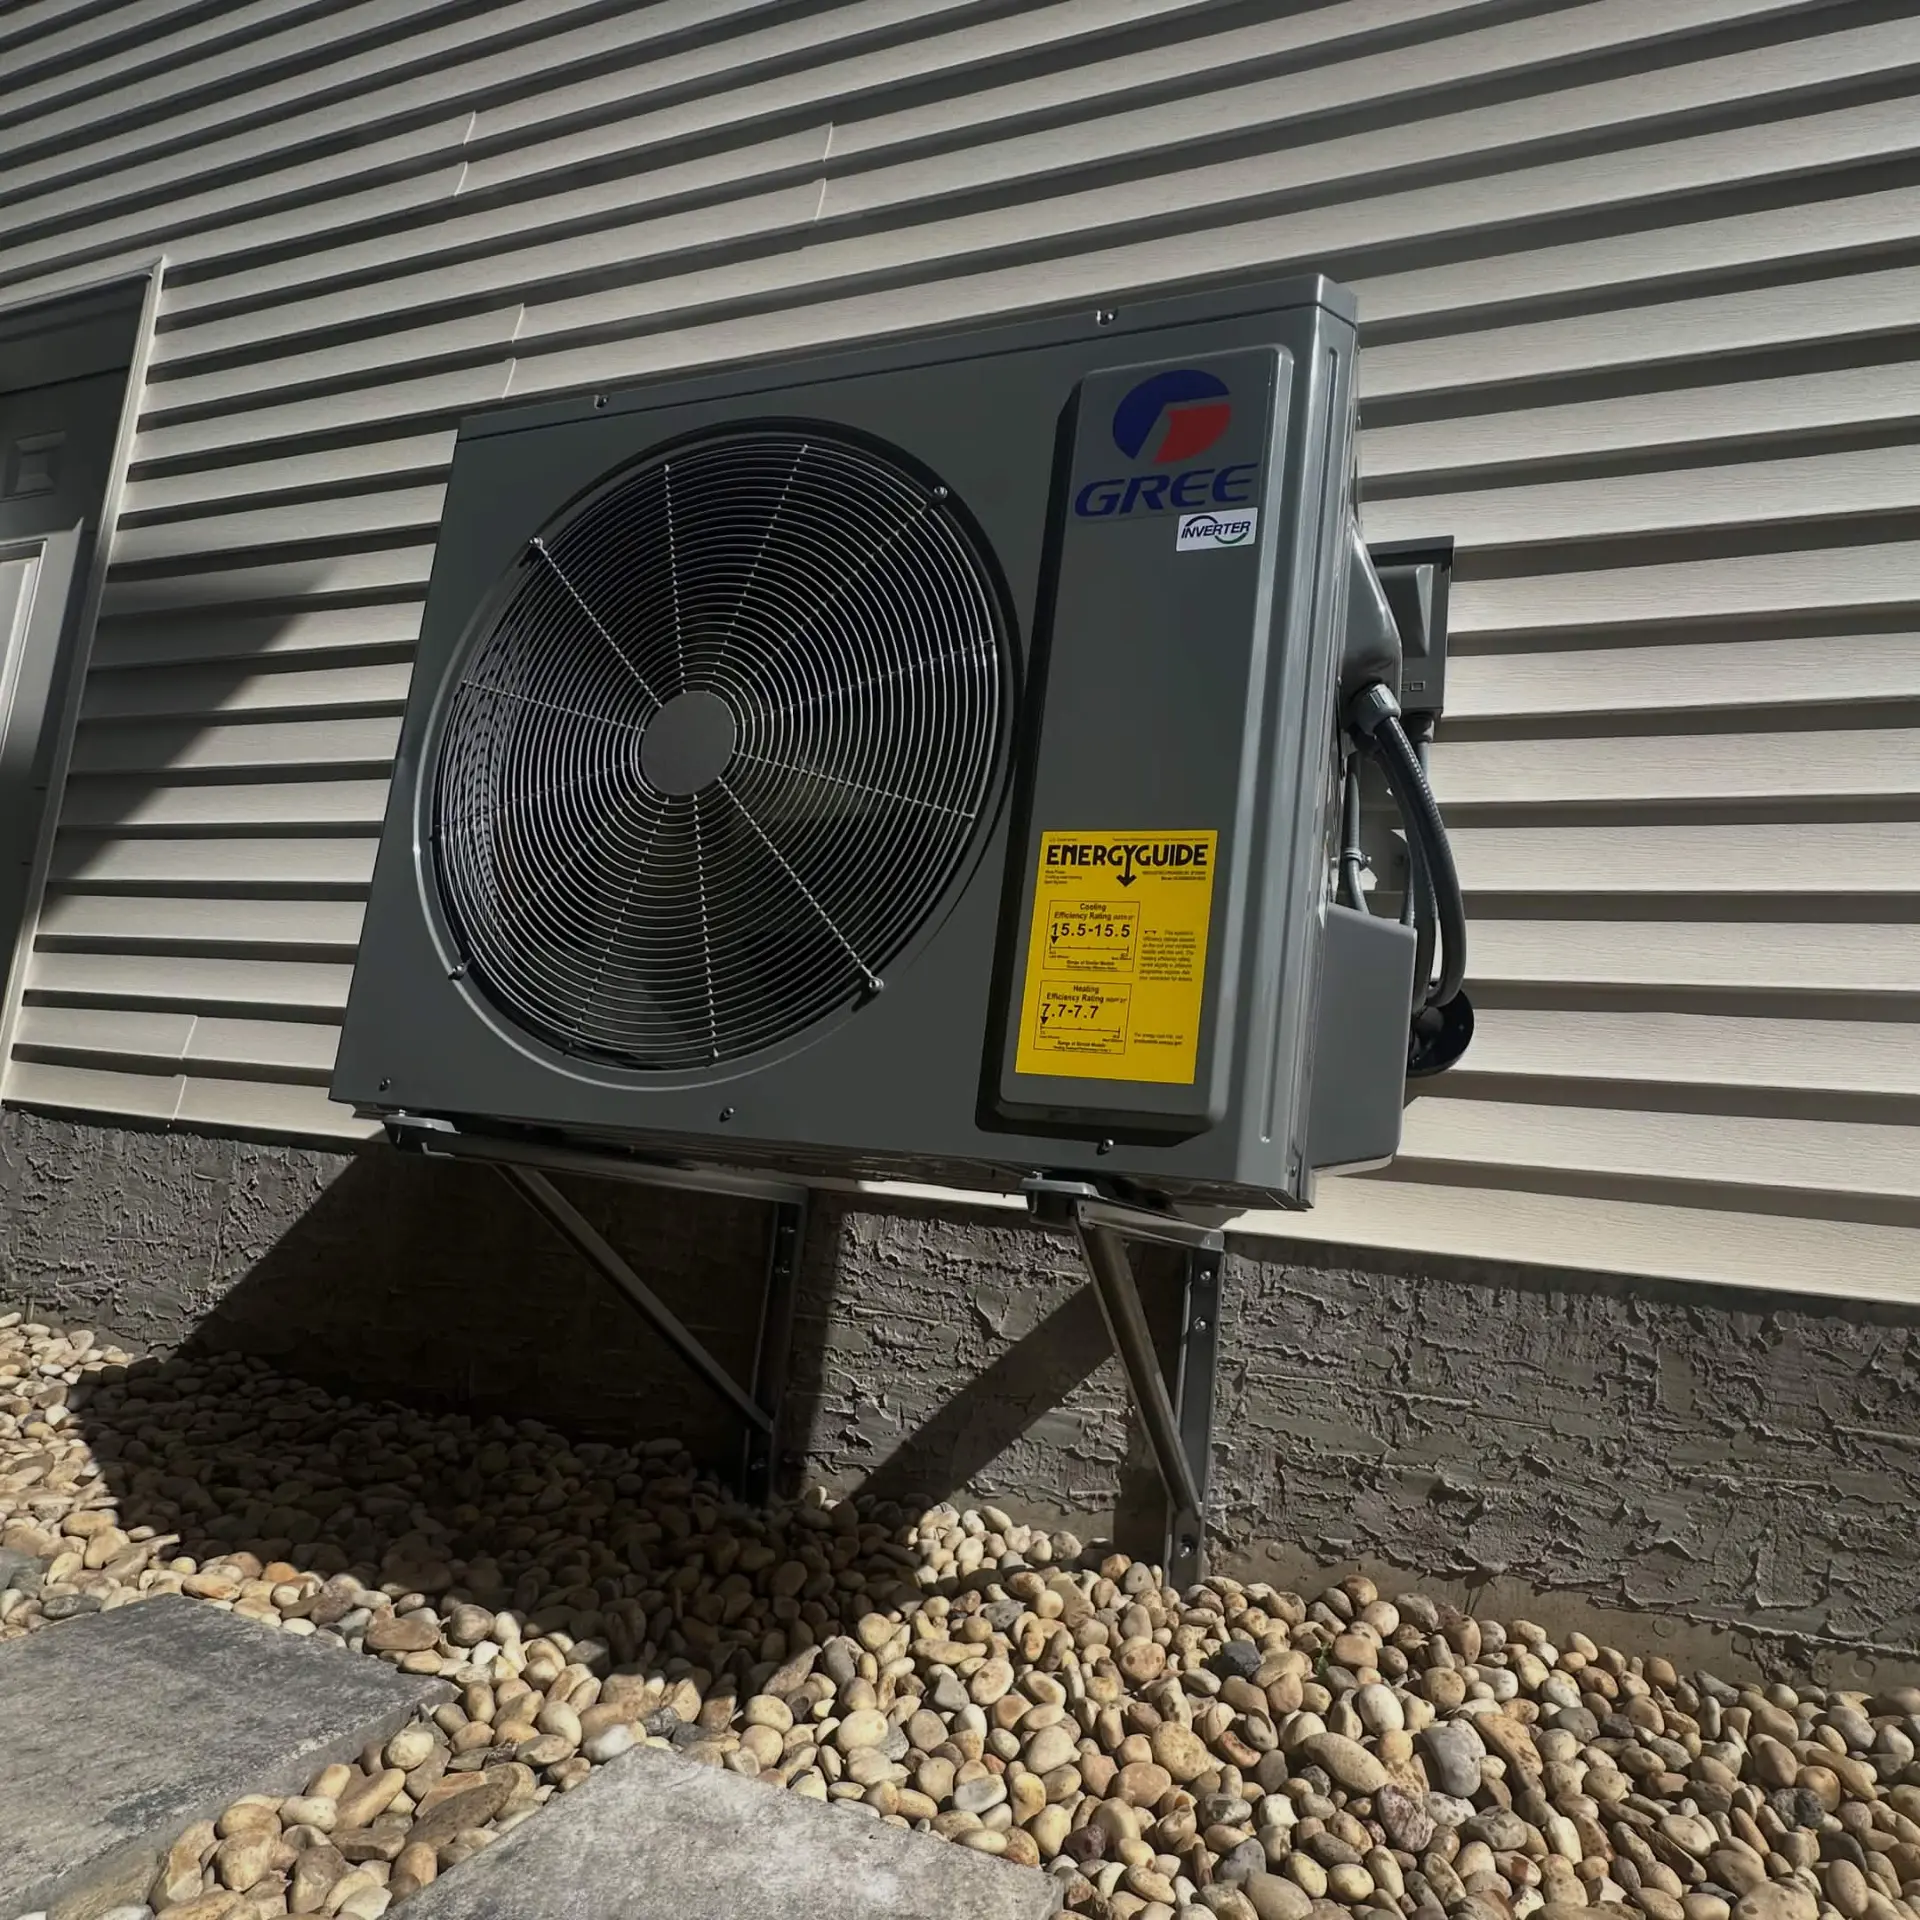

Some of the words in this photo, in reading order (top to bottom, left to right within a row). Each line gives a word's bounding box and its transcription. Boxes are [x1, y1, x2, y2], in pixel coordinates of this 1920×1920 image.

[1075, 462, 1259, 517] GREE
[1181, 520, 1252, 540] INVERTER
[1046, 844, 1209, 868] ENERGYGUIDE
[1080, 903, 1107, 912] Cooling
[1054, 911, 1088, 920] Efficiency
[1089, 912, 1112, 921] Rating
[1051, 923, 1131, 938] 15.5-15.5
[1073, 985, 1100, 994] Heating
[1046, 992, 1080, 1003] Efficiency
[1082, 994, 1104, 1004] Rating
[1041, 1003, 1099, 1019] 7.7-7.7
